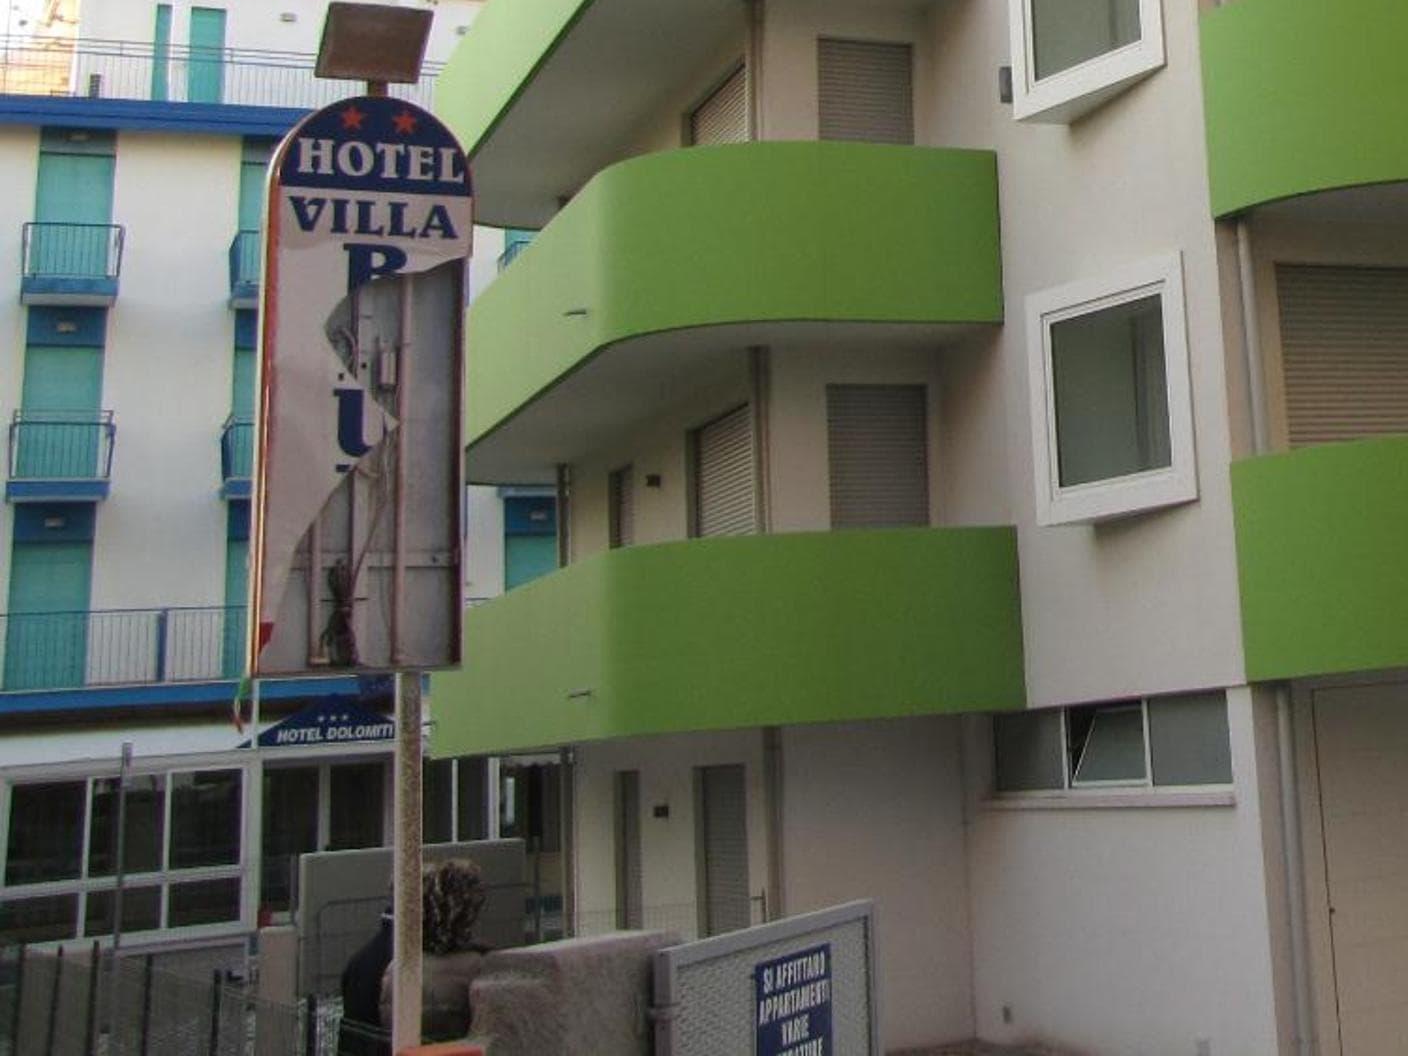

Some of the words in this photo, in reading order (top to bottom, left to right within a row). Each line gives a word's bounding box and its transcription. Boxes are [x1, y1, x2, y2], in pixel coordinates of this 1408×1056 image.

[297, 137, 465, 183] HOTEL
[289, 196, 459, 240] VILLA
[277, 728, 323, 743] HOTEL
[326, 723, 394, 741] DOLOMITI
[775, 951, 825, 991] AFFITTANO
